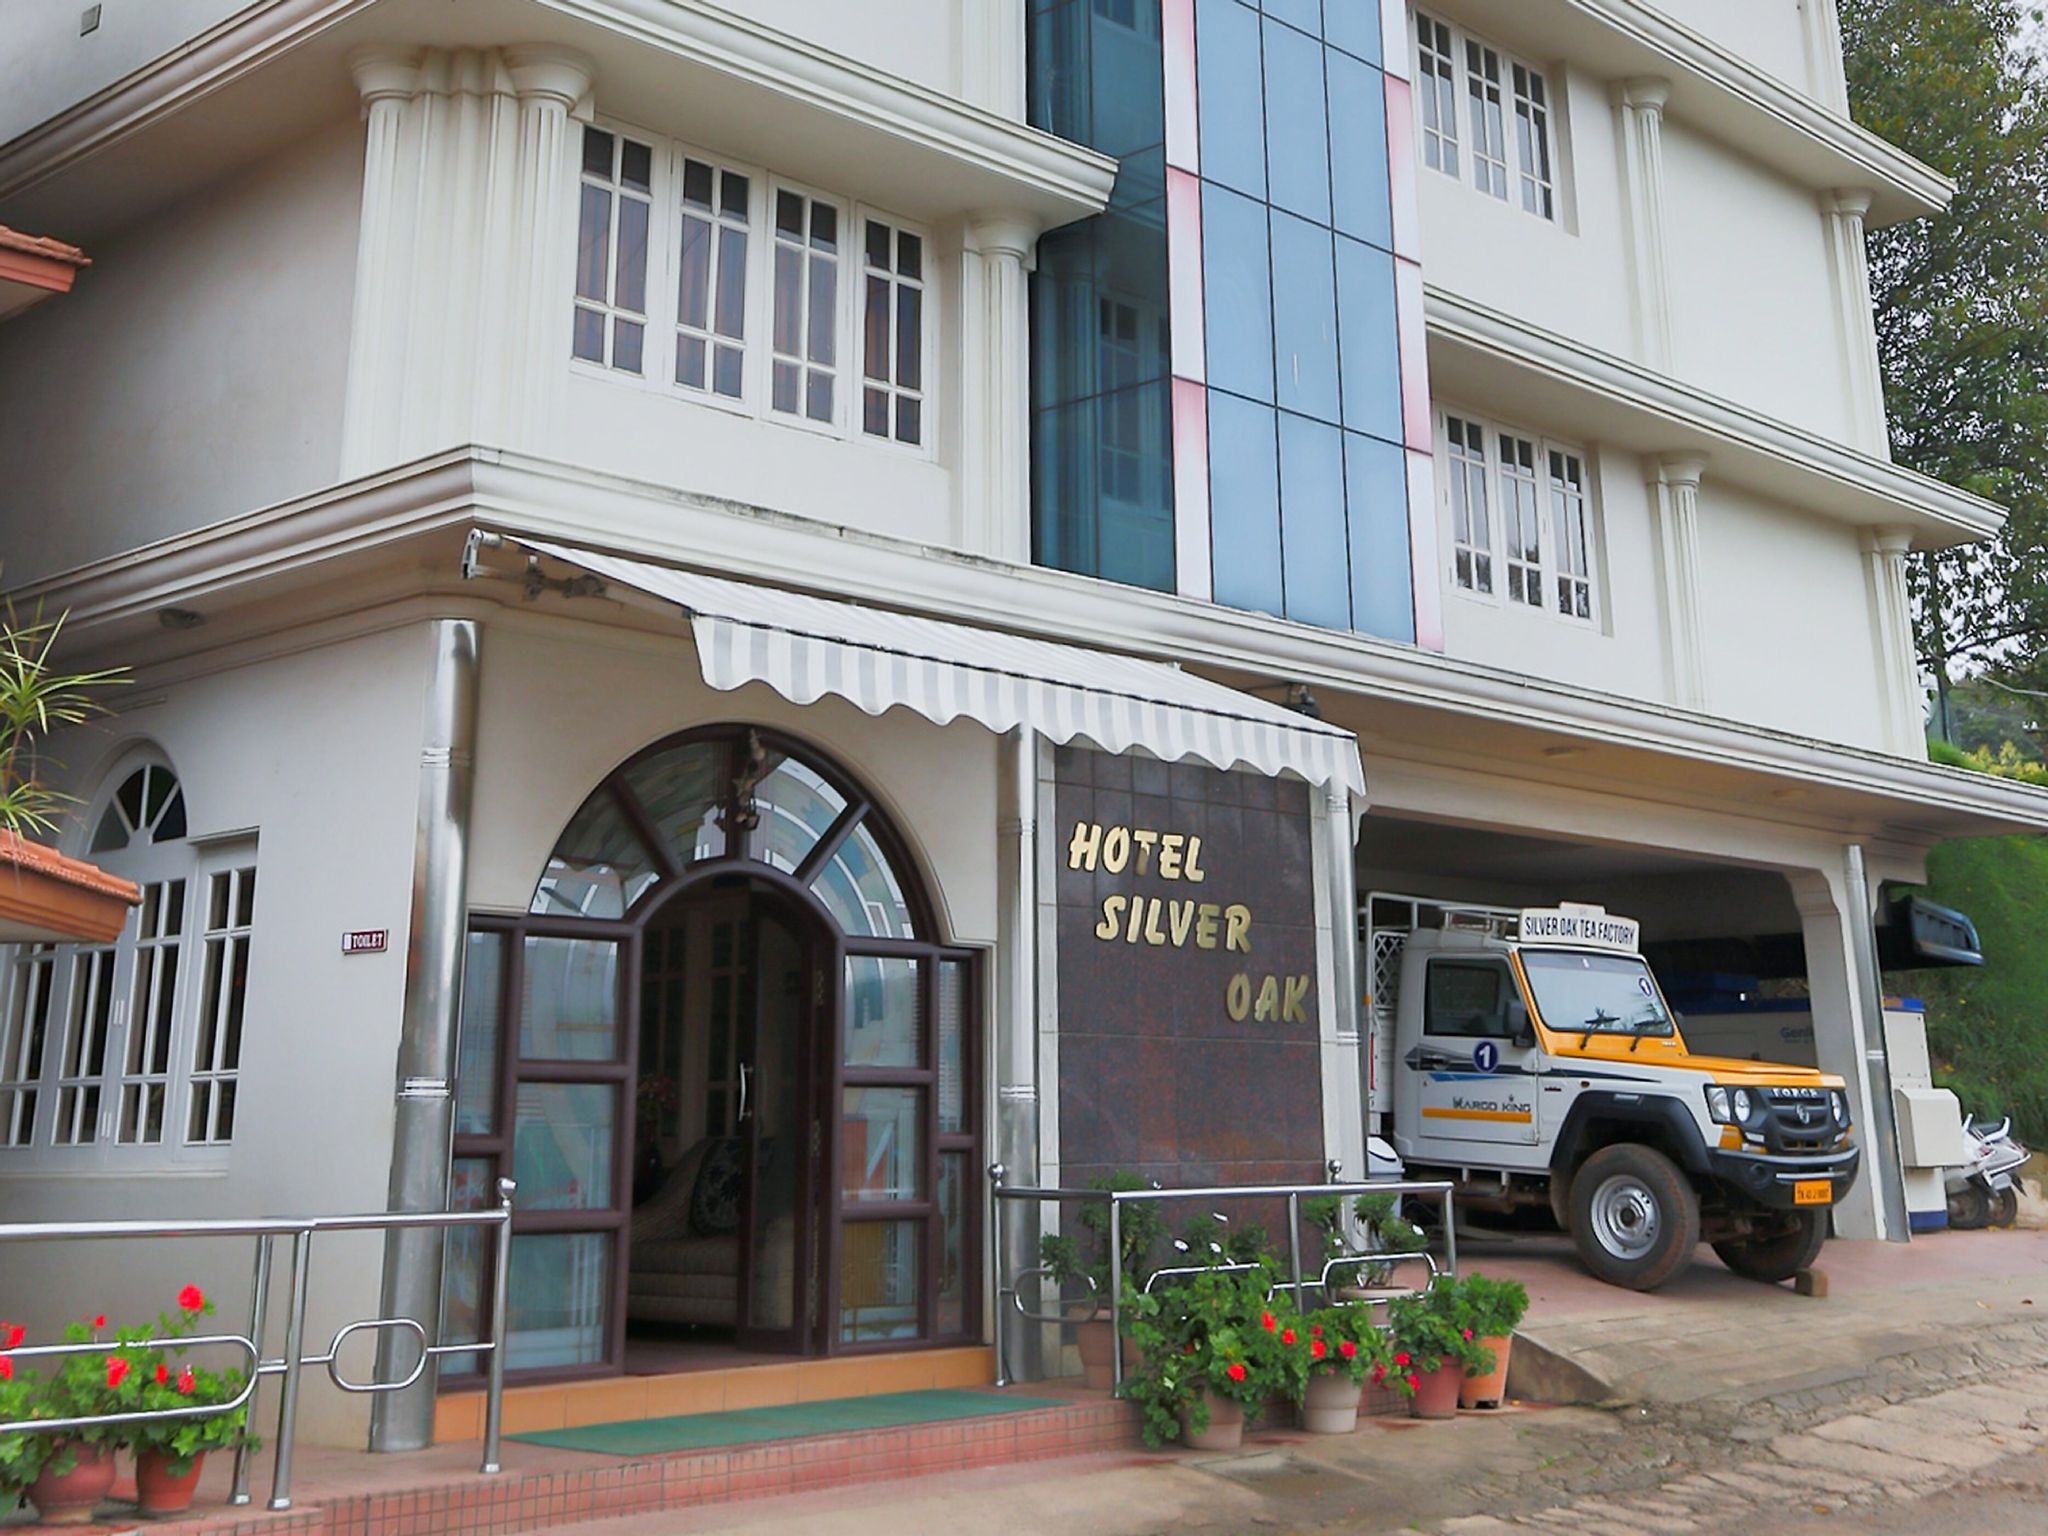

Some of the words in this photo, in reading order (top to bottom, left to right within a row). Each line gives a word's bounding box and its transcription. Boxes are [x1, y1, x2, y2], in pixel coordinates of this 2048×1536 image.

[1068, 821, 1205, 882] HOTEL
[1095, 895, 1251, 953] SILVER
[1525, 916, 1558, 936] SILVER
[1560, 917, 1578, 937] OAK
[1580, 919, 1597, 938] TEA
[1599, 921, 1635, 945] FACTORY
[352, 932, 384, 949] TOILET
[1227, 972, 1310, 1024] OAK
[1478, 1044, 1491, 1069] 1
[1502, 1101, 1532, 1113] KING
